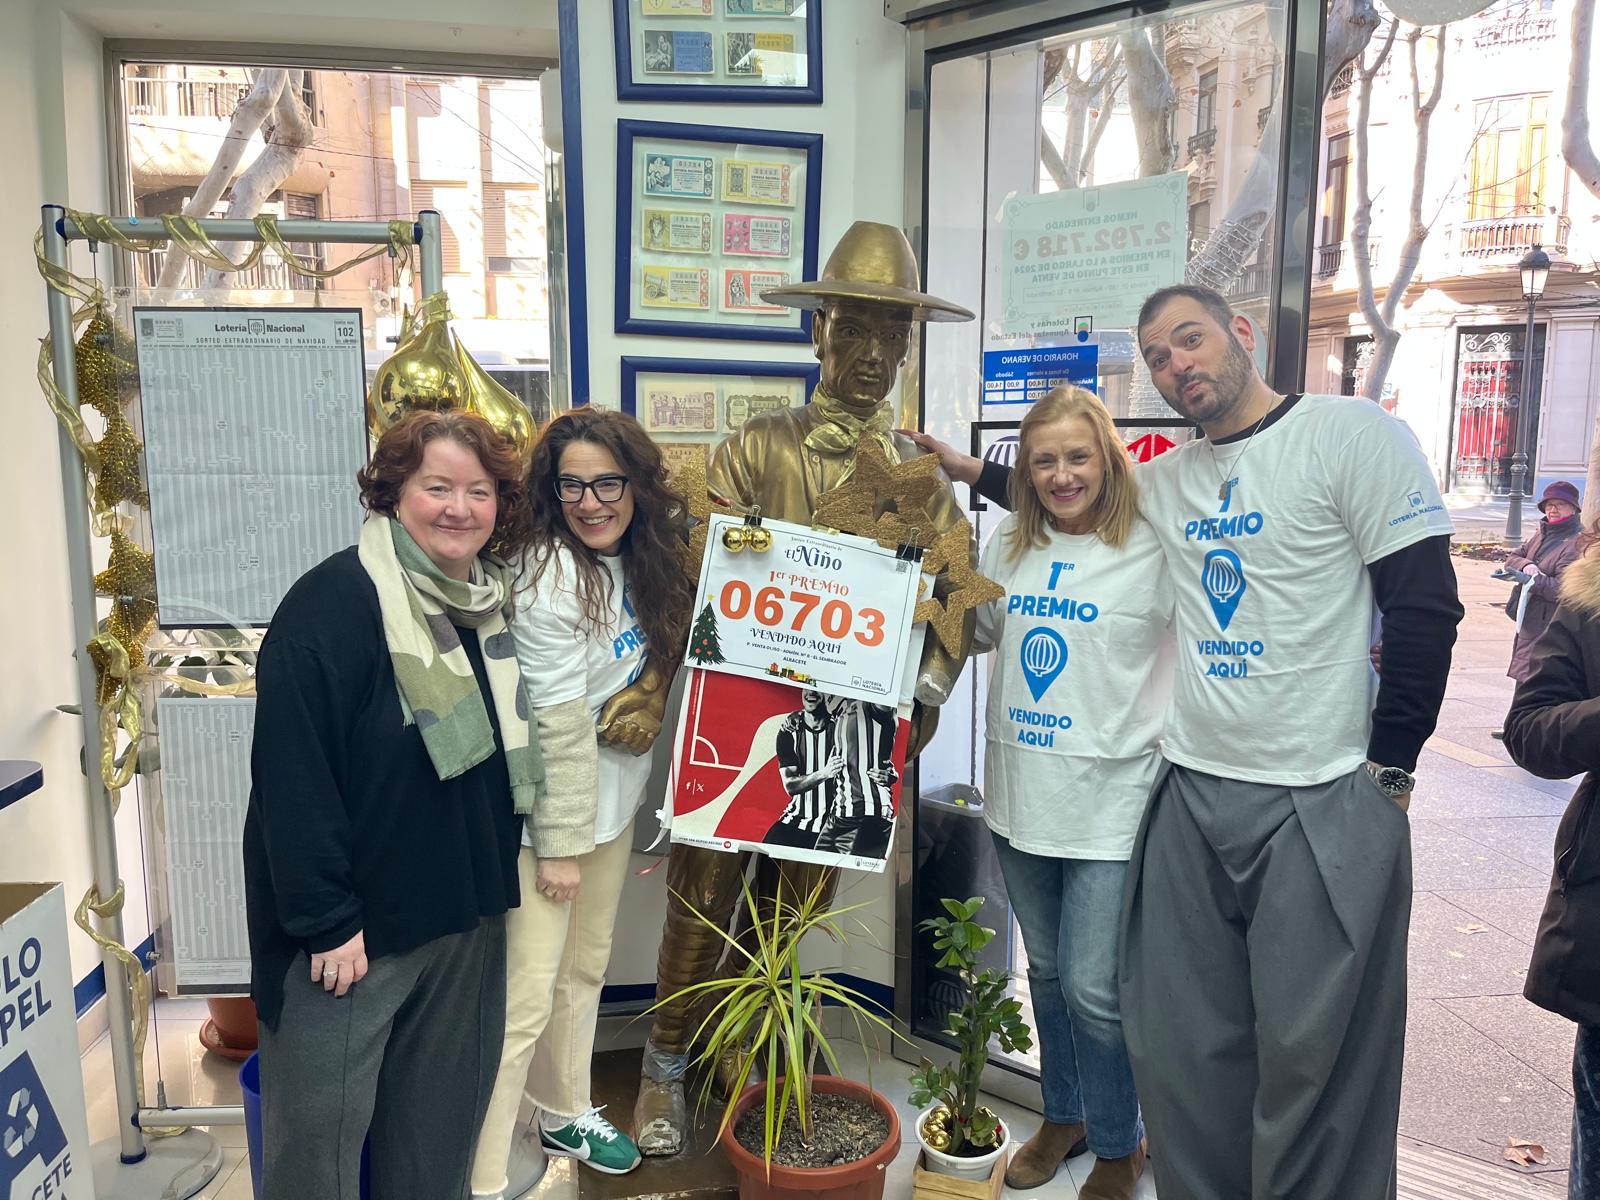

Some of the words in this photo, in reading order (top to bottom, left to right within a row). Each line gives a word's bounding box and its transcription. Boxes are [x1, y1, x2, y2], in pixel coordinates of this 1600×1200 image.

[215, 323, 247, 332] Lotería
[266, 324, 305, 332] Nacional
[337, 327, 354, 337] 102
[1184, 511, 1264, 542] PREMIO
[1388, 511, 1418, 527] LOTERÍA
[794, 545, 843, 571] Niño
[769, 570, 785, 582] 1er
[788, 574, 850, 597] PREMIO
[719, 580, 886, 647] 06703
[1007, 594, 1099, 623] PREMIO
[749, 627, 806, 647] VENDIDO
[806, 639, 842, 655] AQUÍ
[1197, 640, 1264, 657] VENDIDO
[782, 656, 807, 665] ALBACETE
[1205, 658, 1248, 679] AQUÍ
[1008, 706, 1073, 730] VENDIDO
[1017, 729, 1055, 748] AQUÍ
[0, 936, 42, 994] LO
[0, 979, 52, 1047] PEL
